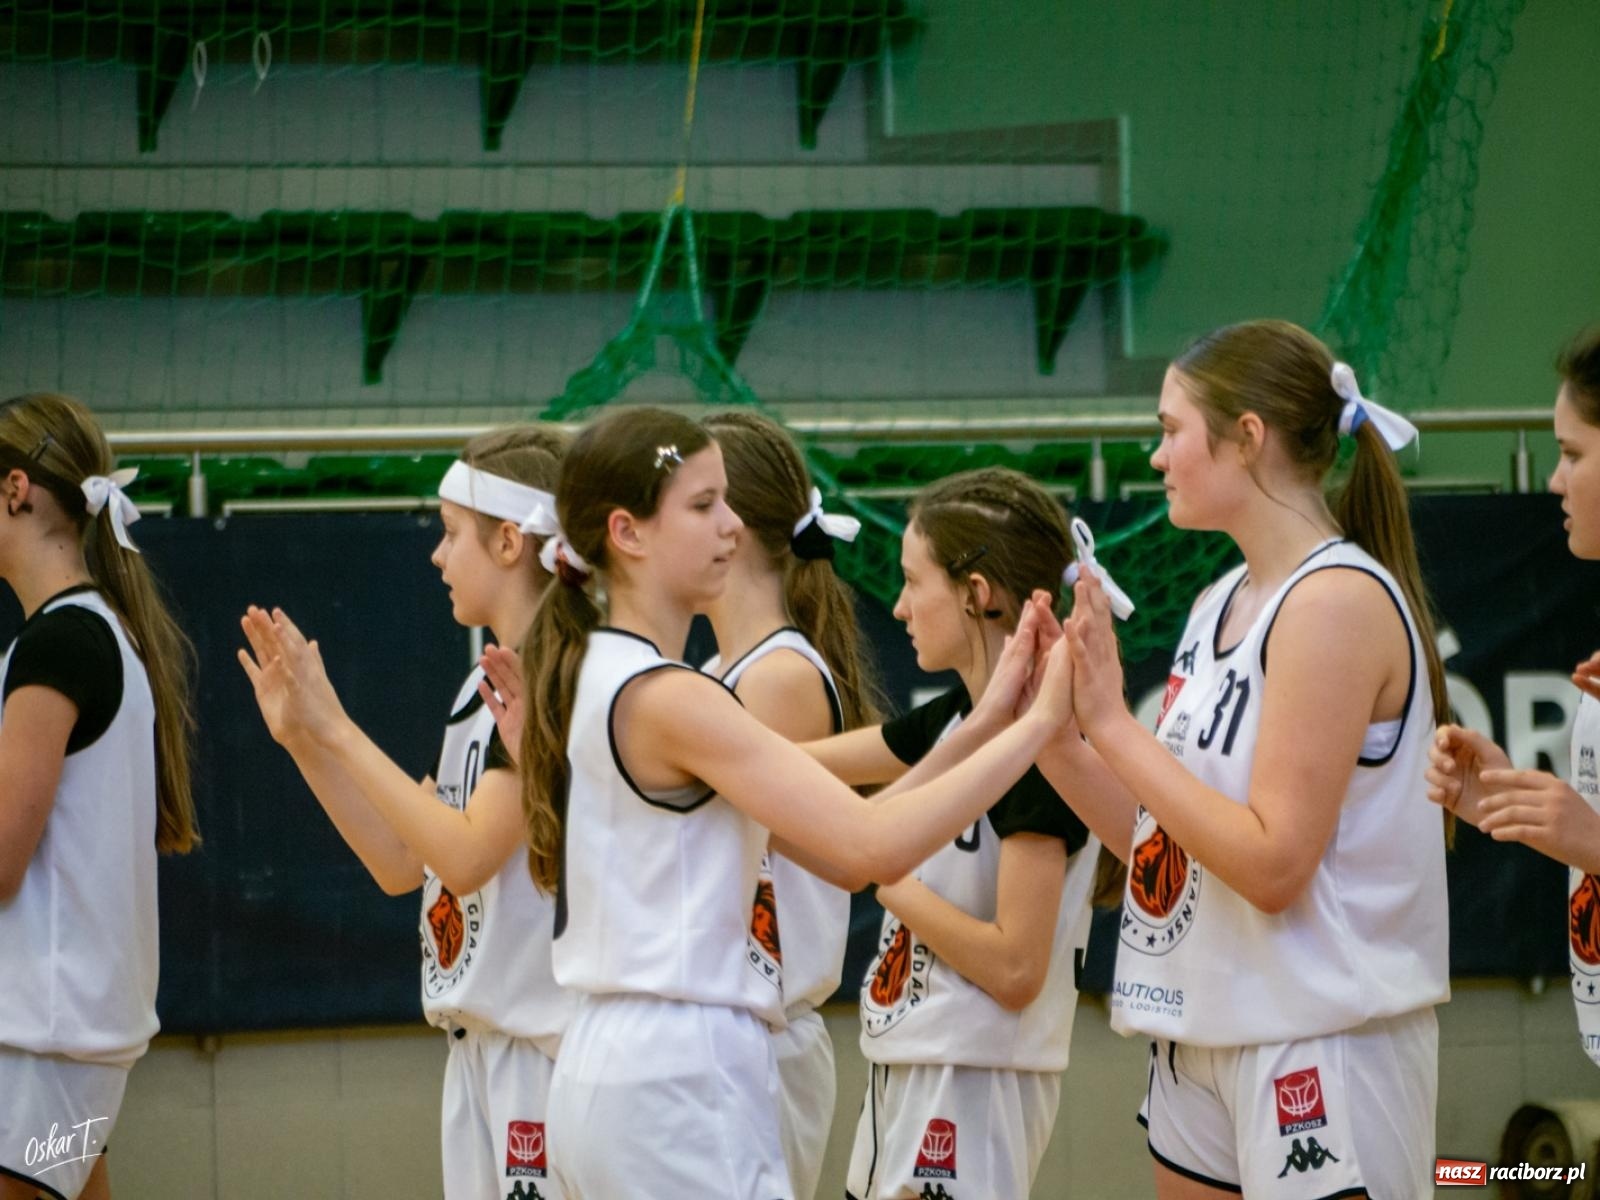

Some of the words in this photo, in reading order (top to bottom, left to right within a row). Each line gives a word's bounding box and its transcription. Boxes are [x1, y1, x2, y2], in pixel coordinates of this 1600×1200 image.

[1198, 668, 1251, 757] 31
[1112, 981, 1184, 1005] AUTIOUS
[1130, 1002, 1183, 1018] LOGISTICS
[1285, 1118, 1323, 1134] PZKOSZ
